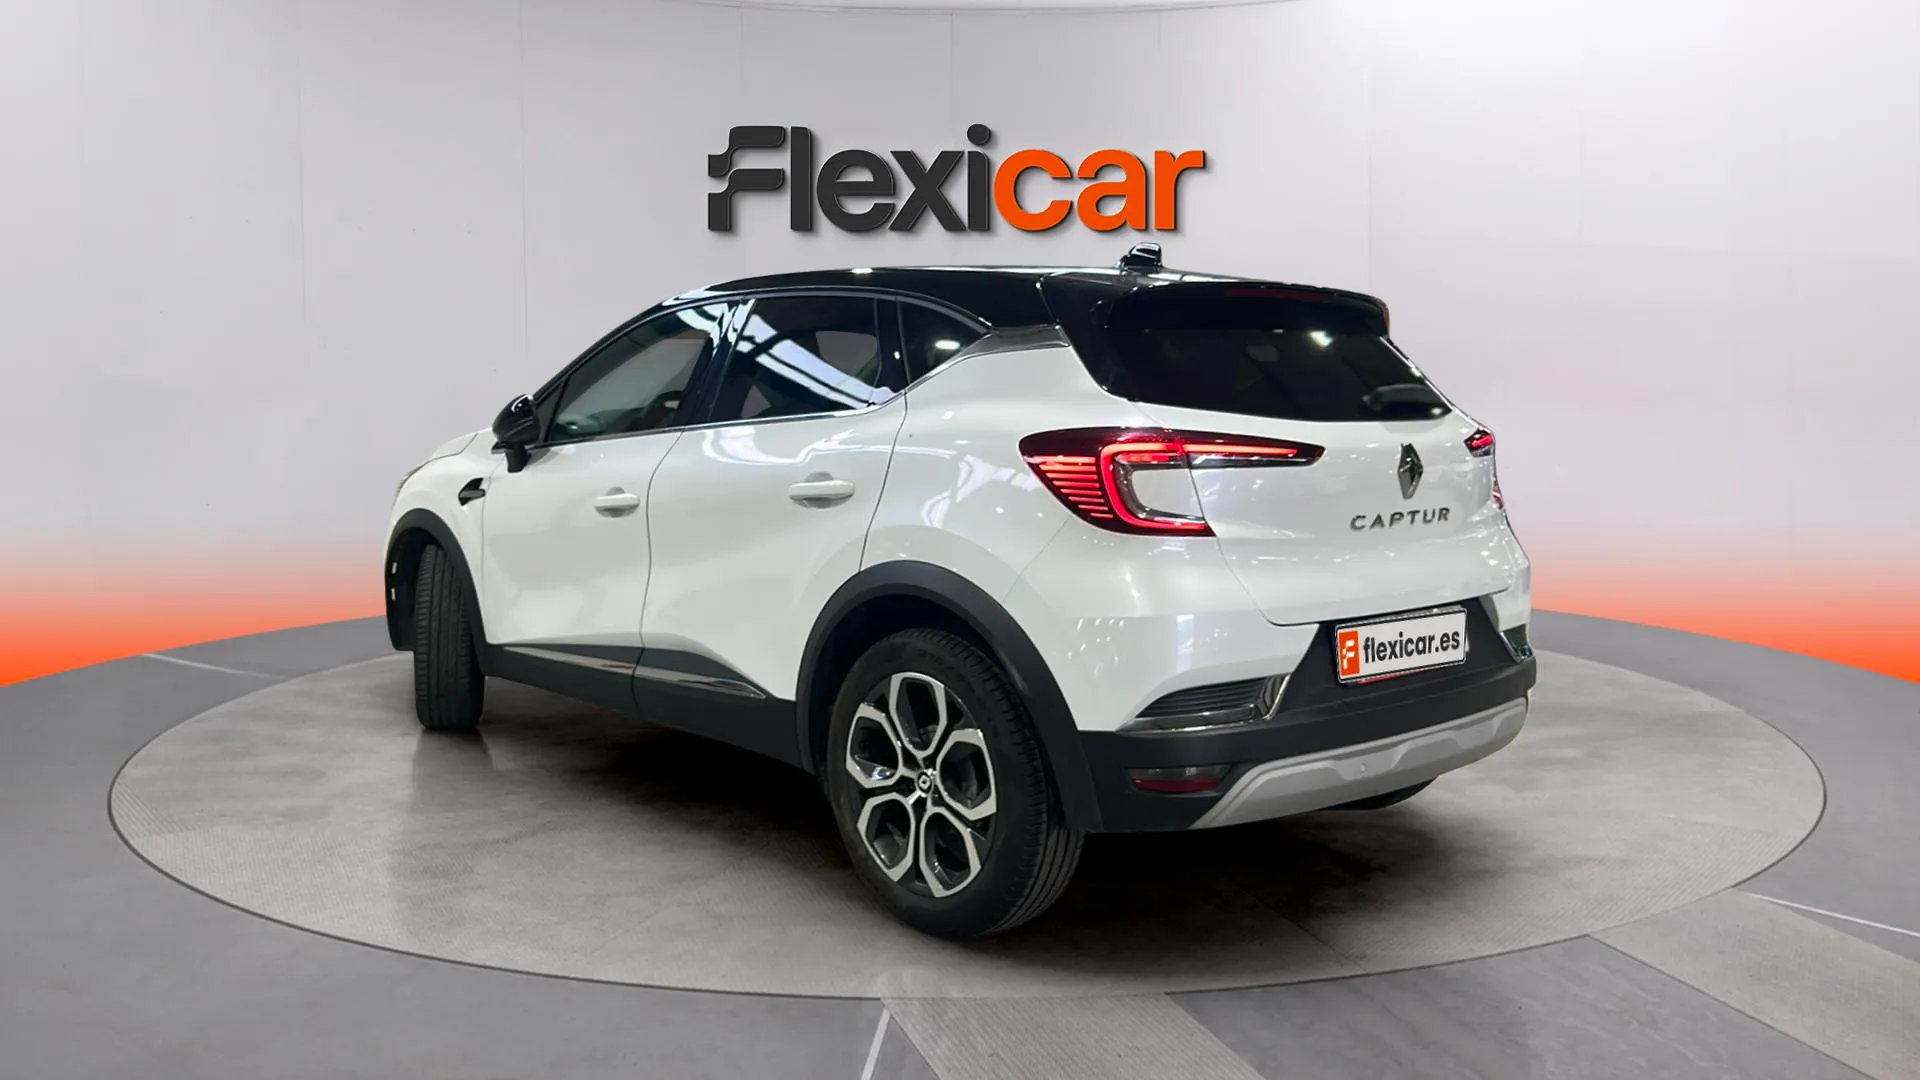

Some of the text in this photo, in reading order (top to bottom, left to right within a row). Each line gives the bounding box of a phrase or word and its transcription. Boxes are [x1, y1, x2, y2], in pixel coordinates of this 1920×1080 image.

[708, 123, 1205, 231] Flexicar
[1350, 507, 1450, 531] CAPTUR
[1363, 631, 1460, 664] flexicar.es
